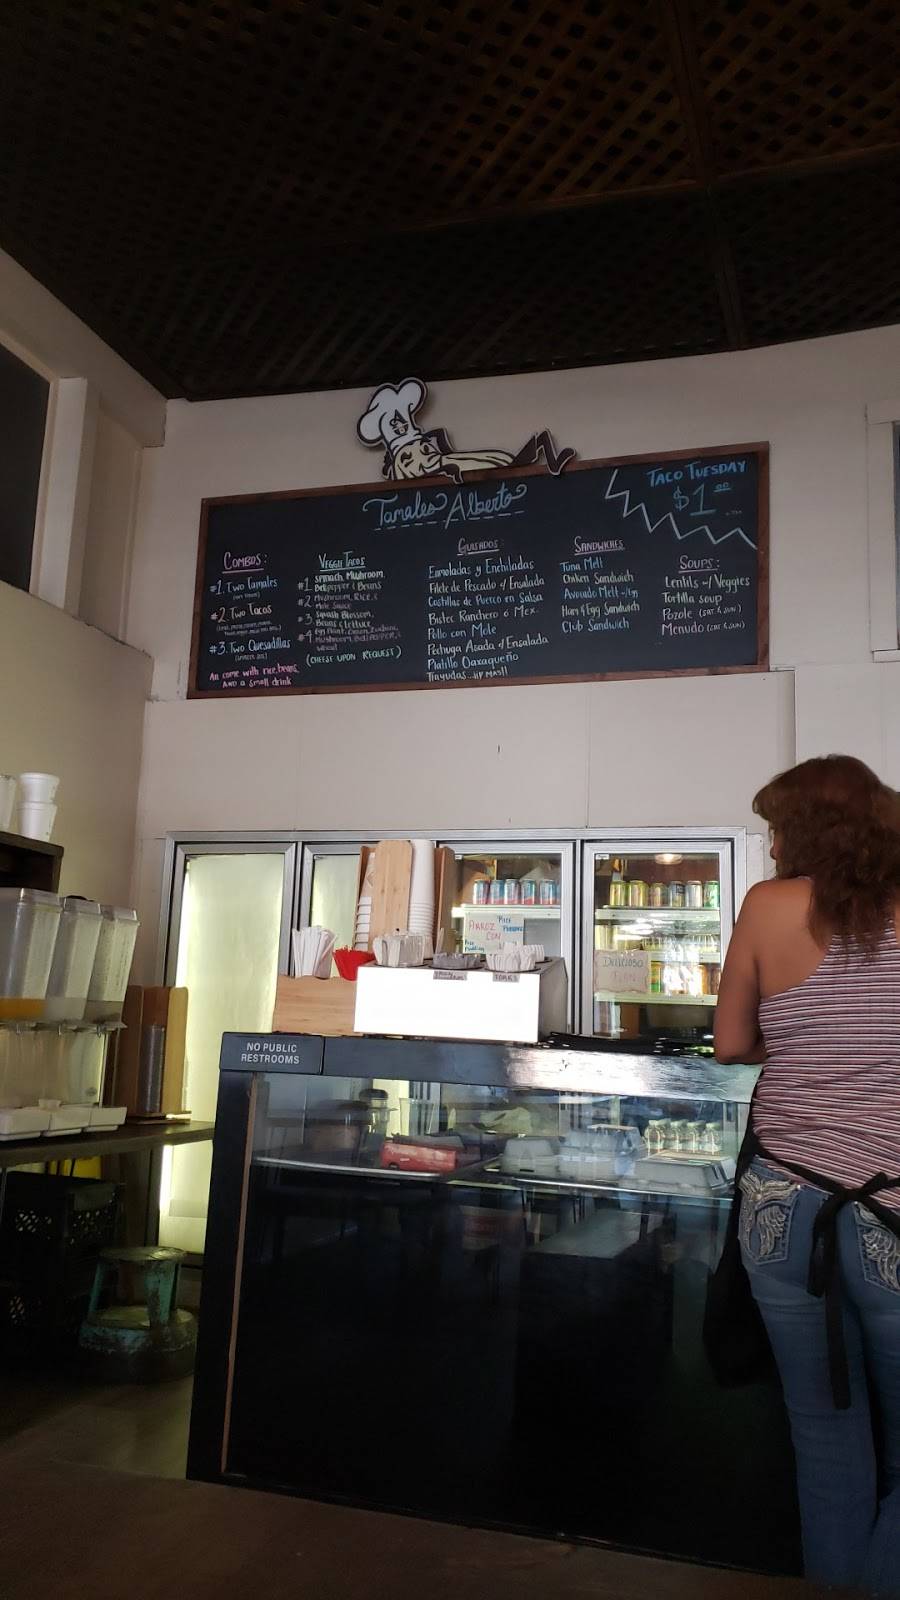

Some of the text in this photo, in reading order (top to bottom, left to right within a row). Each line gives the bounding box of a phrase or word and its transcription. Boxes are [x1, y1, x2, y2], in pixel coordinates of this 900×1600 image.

[647, 460, 746, 487] TACO TUESDAY
[445, 482, 528, 529] Alberto
[428, 555, 535, 579] Enmoladas y Enchiladas
[560, 556, 603, 572] Tuna Melt
[226, 581, 245, 593] Two
[247, 575, 278, 590] Tamales
[429, 580, 449, 594] Filete
[450, 580, 461, 592] de
[464, 578, 497, 592] Pescado
[509, 573, 545, 590] Ensalada
[594, 569, 634, 585] Sandwich
[665, 576, 699, 589] Lentils
[714, 573, 751, 593] Veggies
[428, 596, 460, 608] Costillas
[463, 596, 472, 606] de
[475, 595, 501, 607] Puerco
[519, 591, 544, 604] Salsa
[564, 586, 597, 600] Avocado
[599, 585, 619, 599] Melt
[661, 592, 722, 606] Tortilla soup
[230, 606, 246, 620] Two
[248, 602, 273, 615] Tacos
[562, 605, 579, 617] Ham
[585, 602, 601, 617] Egg
[604, 600, 641, 616] Sandwich
[662, 607, 693, 621] Pozole
[428, 611, 454, 626] Bistec
[459, 609, 499, 623] Ranchero
[562, 616, 630, 633] Club Sandwich
[428, 622, 497, 640] Pollo con Mole
[662, 621, 705, 636] Menudo
[230, 641, 245, 654] Two
[248, 636, 291, 652] Quesadillas
[428, 644, 462, 658] Pechuga
[465, 639, 496, 653] Asada
[506, 633, 549, 650] Ensalada
[336, 653, 356, 662] UPON
[427, 652, 519, 671] Platillo Oaxaqueño
[222, 669, 240, 679] come
[242, 665, 260, 677] with
[271, 676, 292, 686] drink
[246, 1042, 297, 1053] NO PUBLIC
[241, 1053, 300, 1065] RESTROOMS
